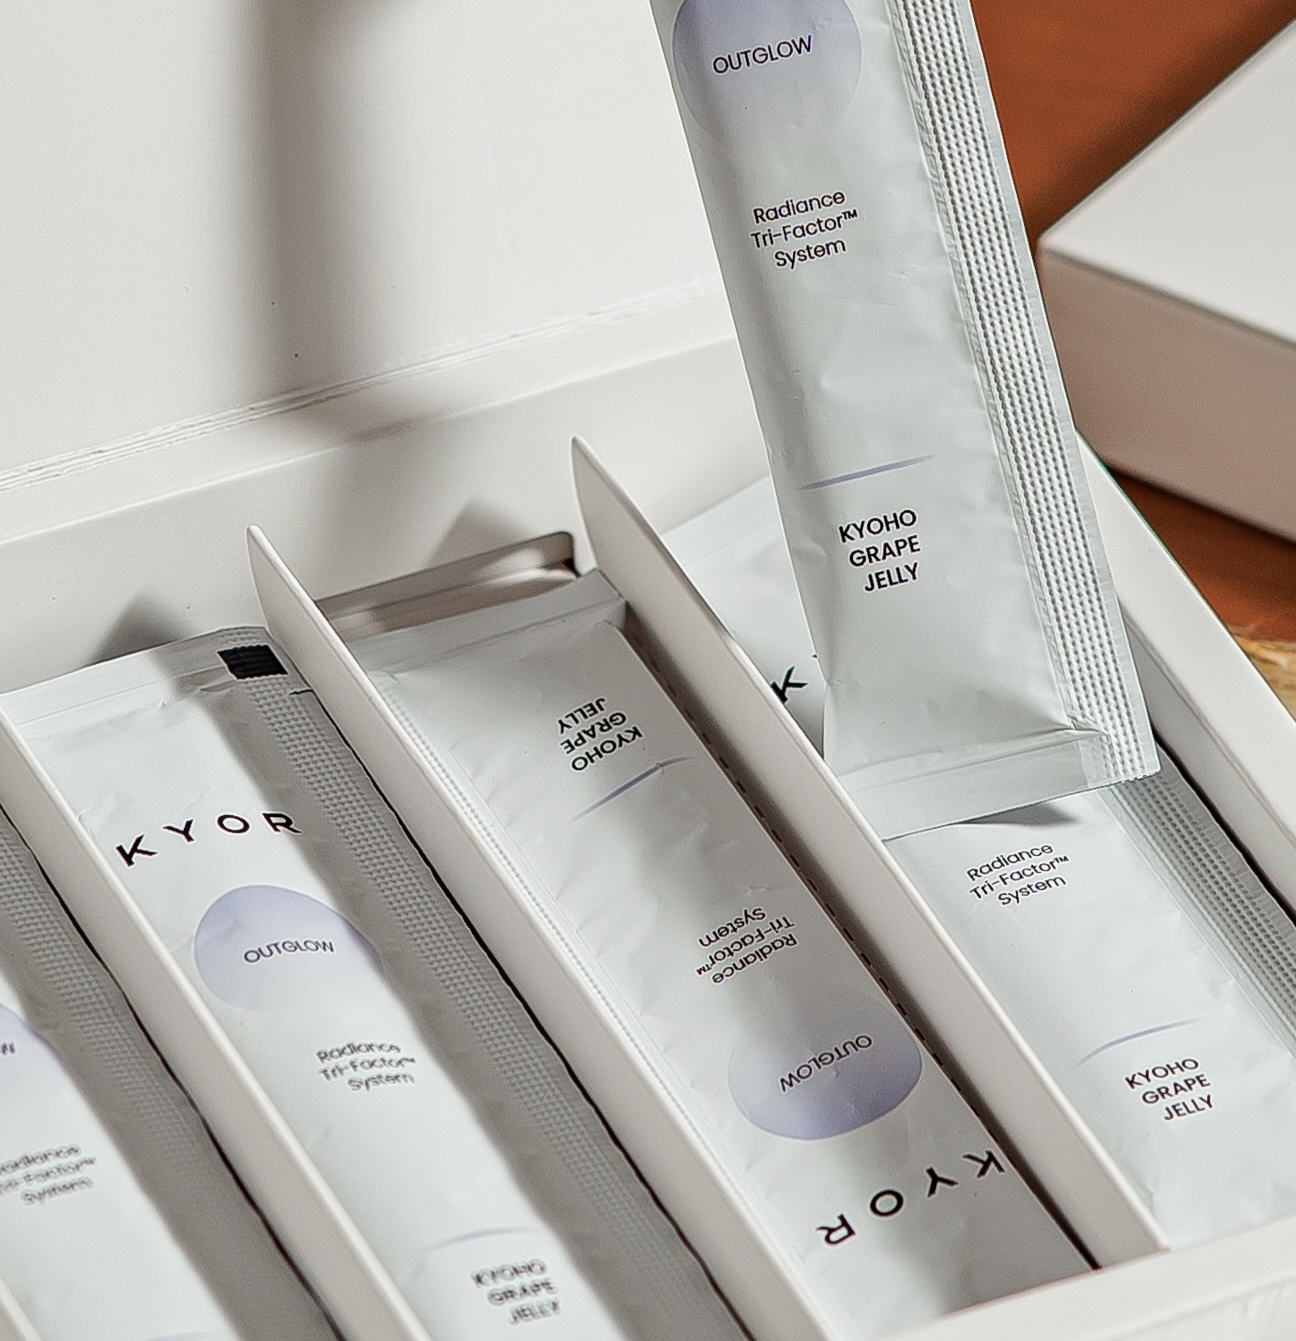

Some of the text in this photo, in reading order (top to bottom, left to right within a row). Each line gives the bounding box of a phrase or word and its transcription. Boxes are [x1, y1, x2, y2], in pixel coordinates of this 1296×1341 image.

[712, 35, 813, 74] OUTGLOW
[753, 189, 846, 224] Radiance
[774, 236, 846, 268] System
[839, 509, 918, 544] KYOHO
[849, 536, 921, 568] GRAPE
[864, 562, 920, 593] JELLY
[557, 697, 605, 734] JELLY
[560, 711, 627, 754] GRAPE
[570, 724, 644, 773] KYOHO
[115, 811, 302, 867] KYOR
[966, 842, 1054, 882] Radiance
[997, 872, 1067, 908] System
[698, 907, 767, 948] System
[242, 939, 335, 964] OUTGLOW
[711, 932, 798, 985] Radiance
[778, 1033, 874, 1094] OUTGLOW
[1124, 1057, 1201, 1091] KYOHO
[1141, 1072, 1212, 1107] GRAPE
[1163, 1095, 1215, 1122] JELLY
[816, 1149, 1006, 1248] KYOR
